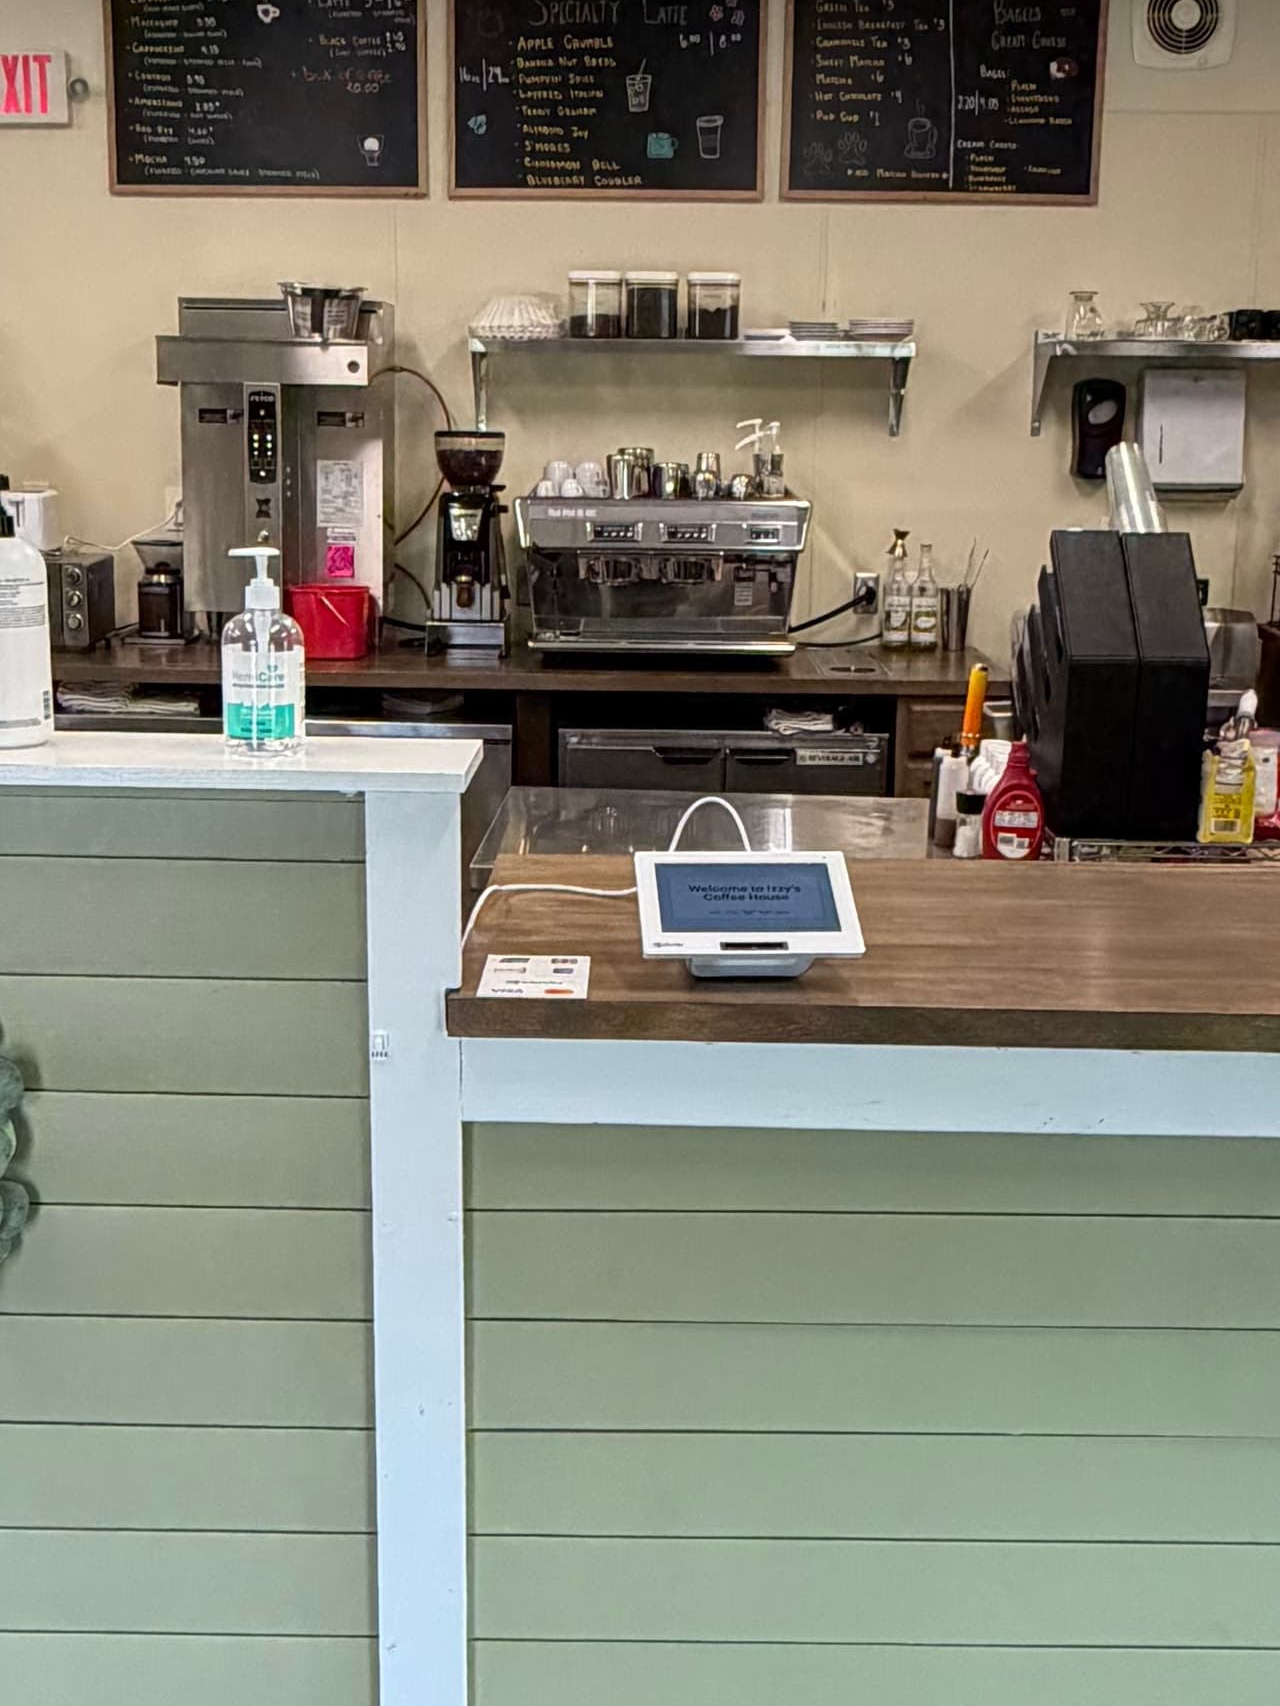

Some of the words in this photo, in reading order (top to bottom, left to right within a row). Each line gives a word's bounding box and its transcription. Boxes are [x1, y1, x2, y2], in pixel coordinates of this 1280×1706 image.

[517, 36, 554, 51] APPLE
[563, 34, 614, 50] CRUMBLE
[522, 124, 564, 135] ALMOND
[526, 174, 584, 186] BLUEBERRY
[688, 884, 748, 893] Welcome
[767, 885, 802, 895] Izzy's
[703, 893, 745, 901] Coffee
[749, 893, 789, 901] House
